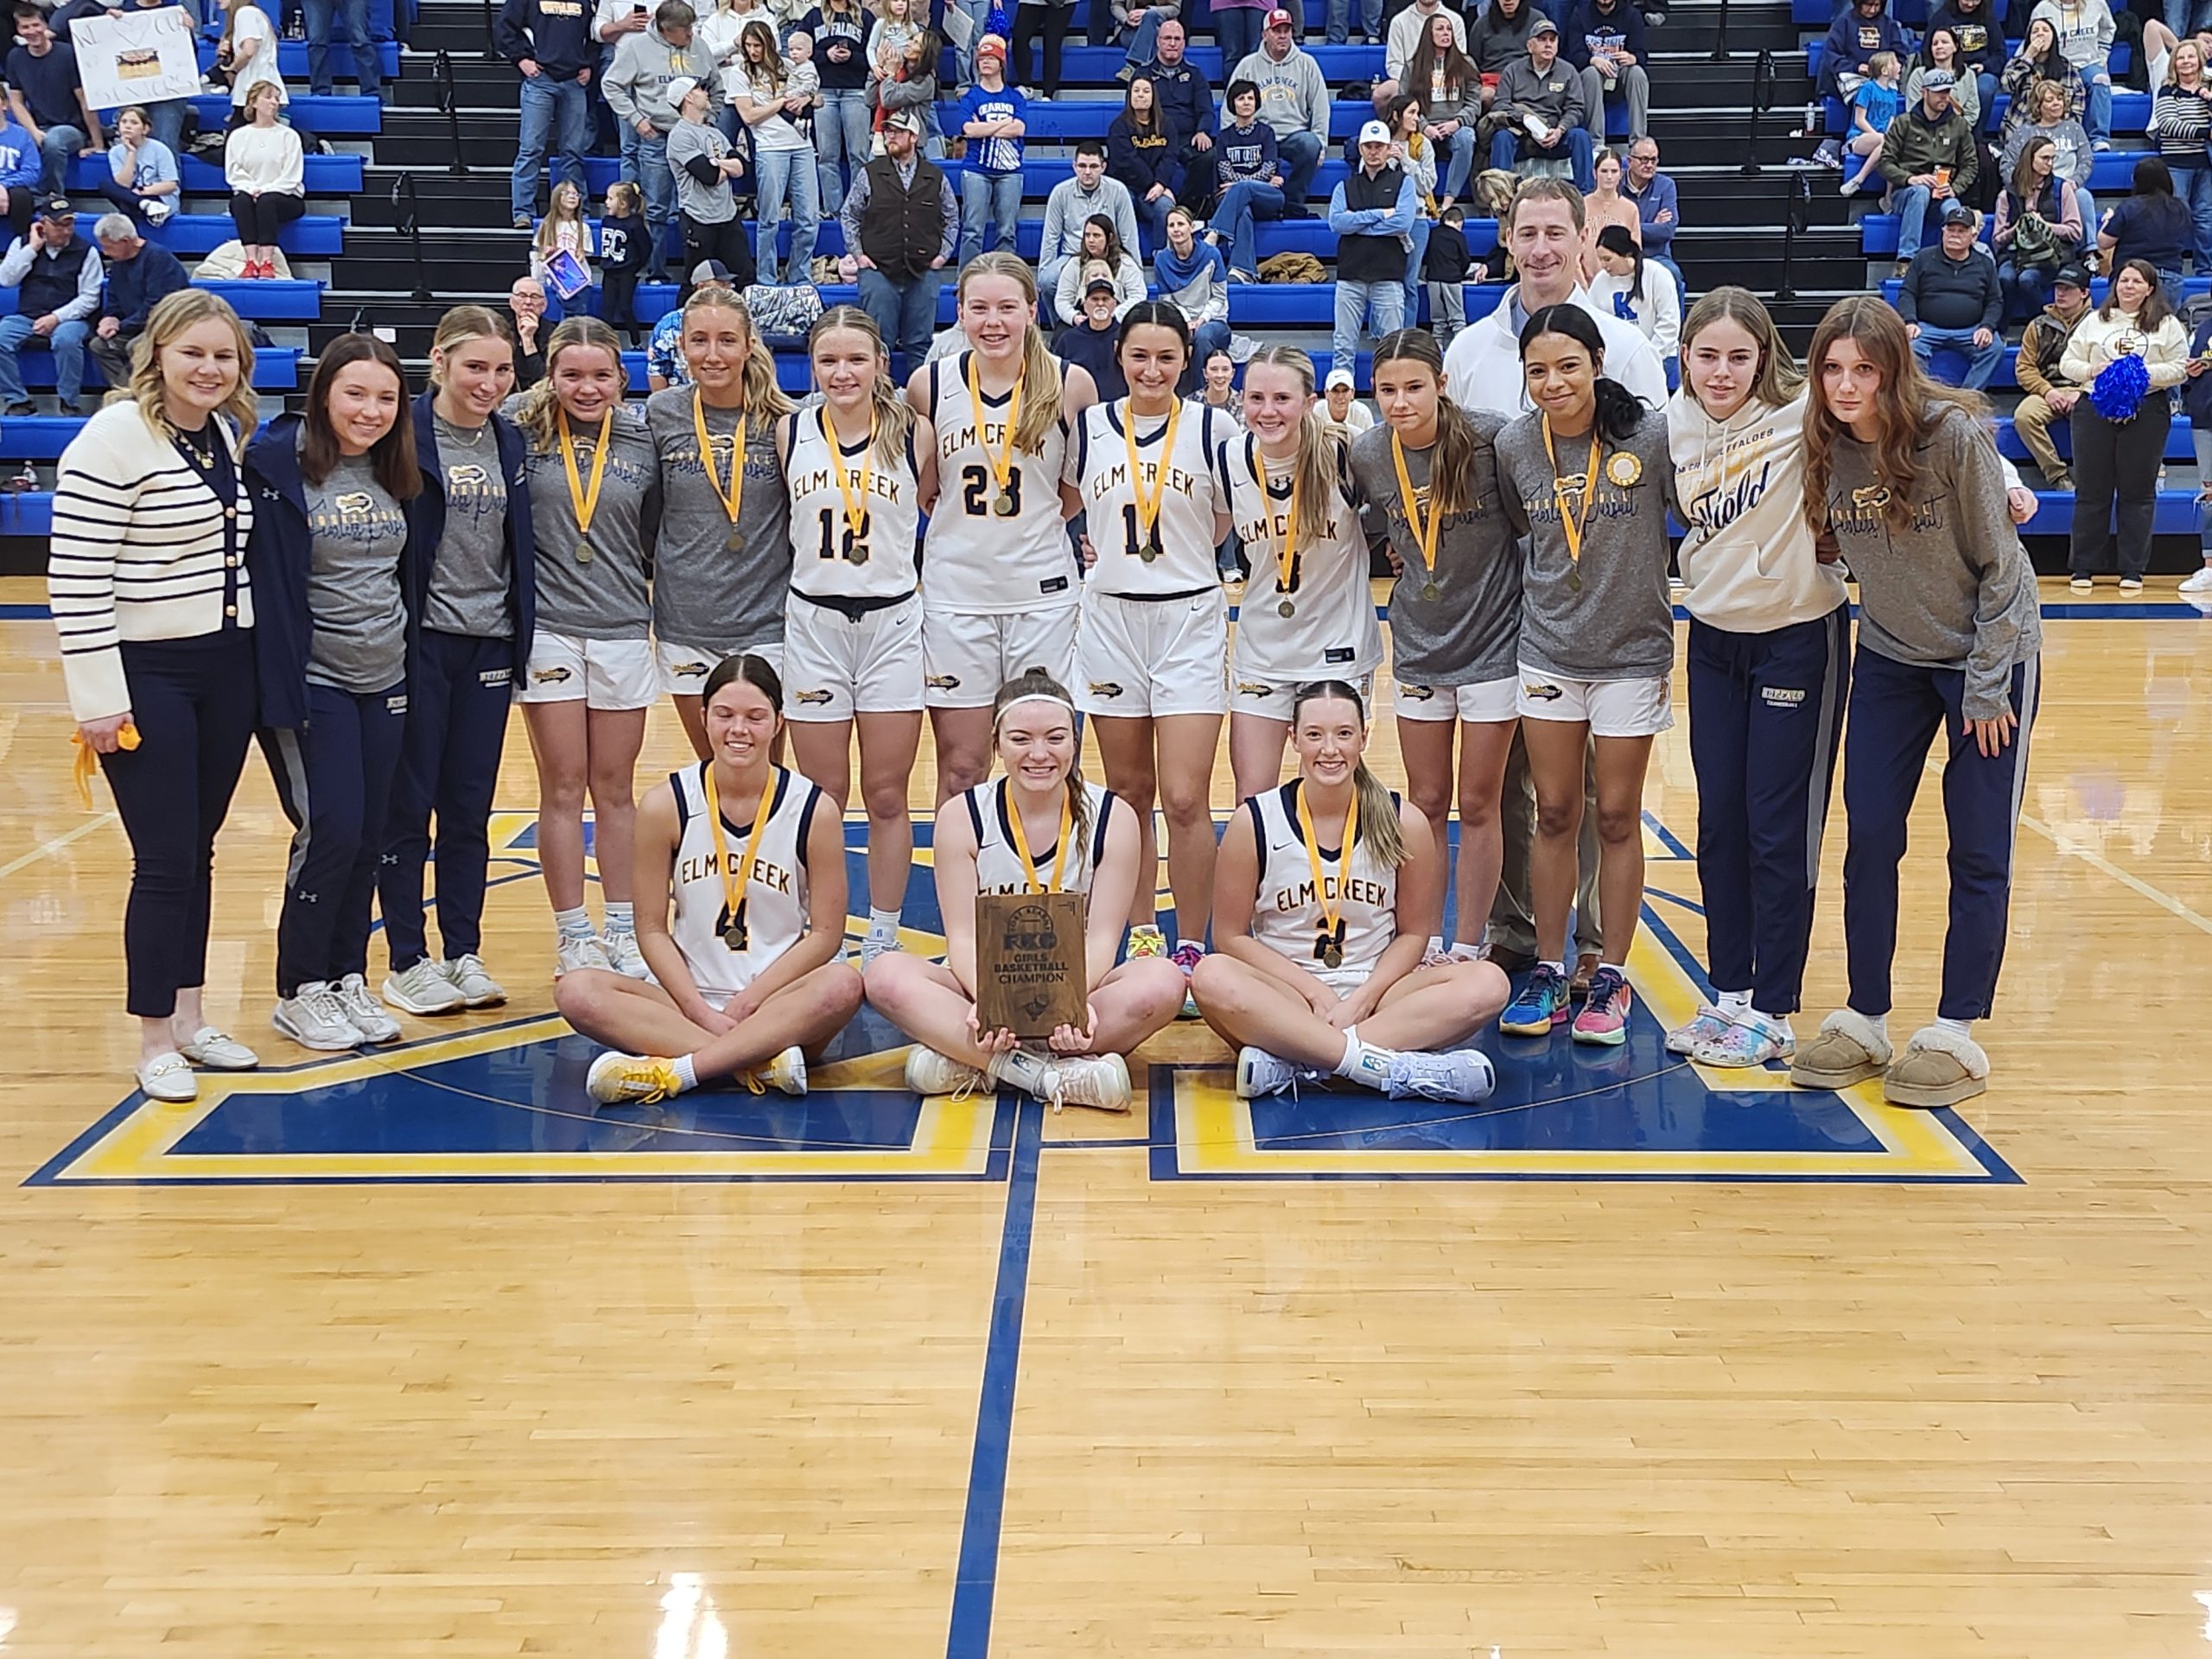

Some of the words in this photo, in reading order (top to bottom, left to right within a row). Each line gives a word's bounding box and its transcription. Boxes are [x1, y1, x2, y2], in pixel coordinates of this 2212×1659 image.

[1612, 290, 1639, 321] K
[942, 425, 976, 461] ELM
[984, 423, 1046, 462] CRK
[793, 468, 830, 502] ELM
[835, 468, 900, 505] REEK
[1093, 462, 1126, 501] ELM
[817, 506, 871, 562] 12
[1241, 518, 1269, 545] ELM
[682, 853, 719, 886] ELM
[1276, 879, 1316, 912] ELM
[713, 896, 749, 953] 4
[994, 962, 1070, 973] BASKETBALL
[1014, 952, 1049, 963] GIRLS
[999, 972, 1065, 985] CHAMPION
